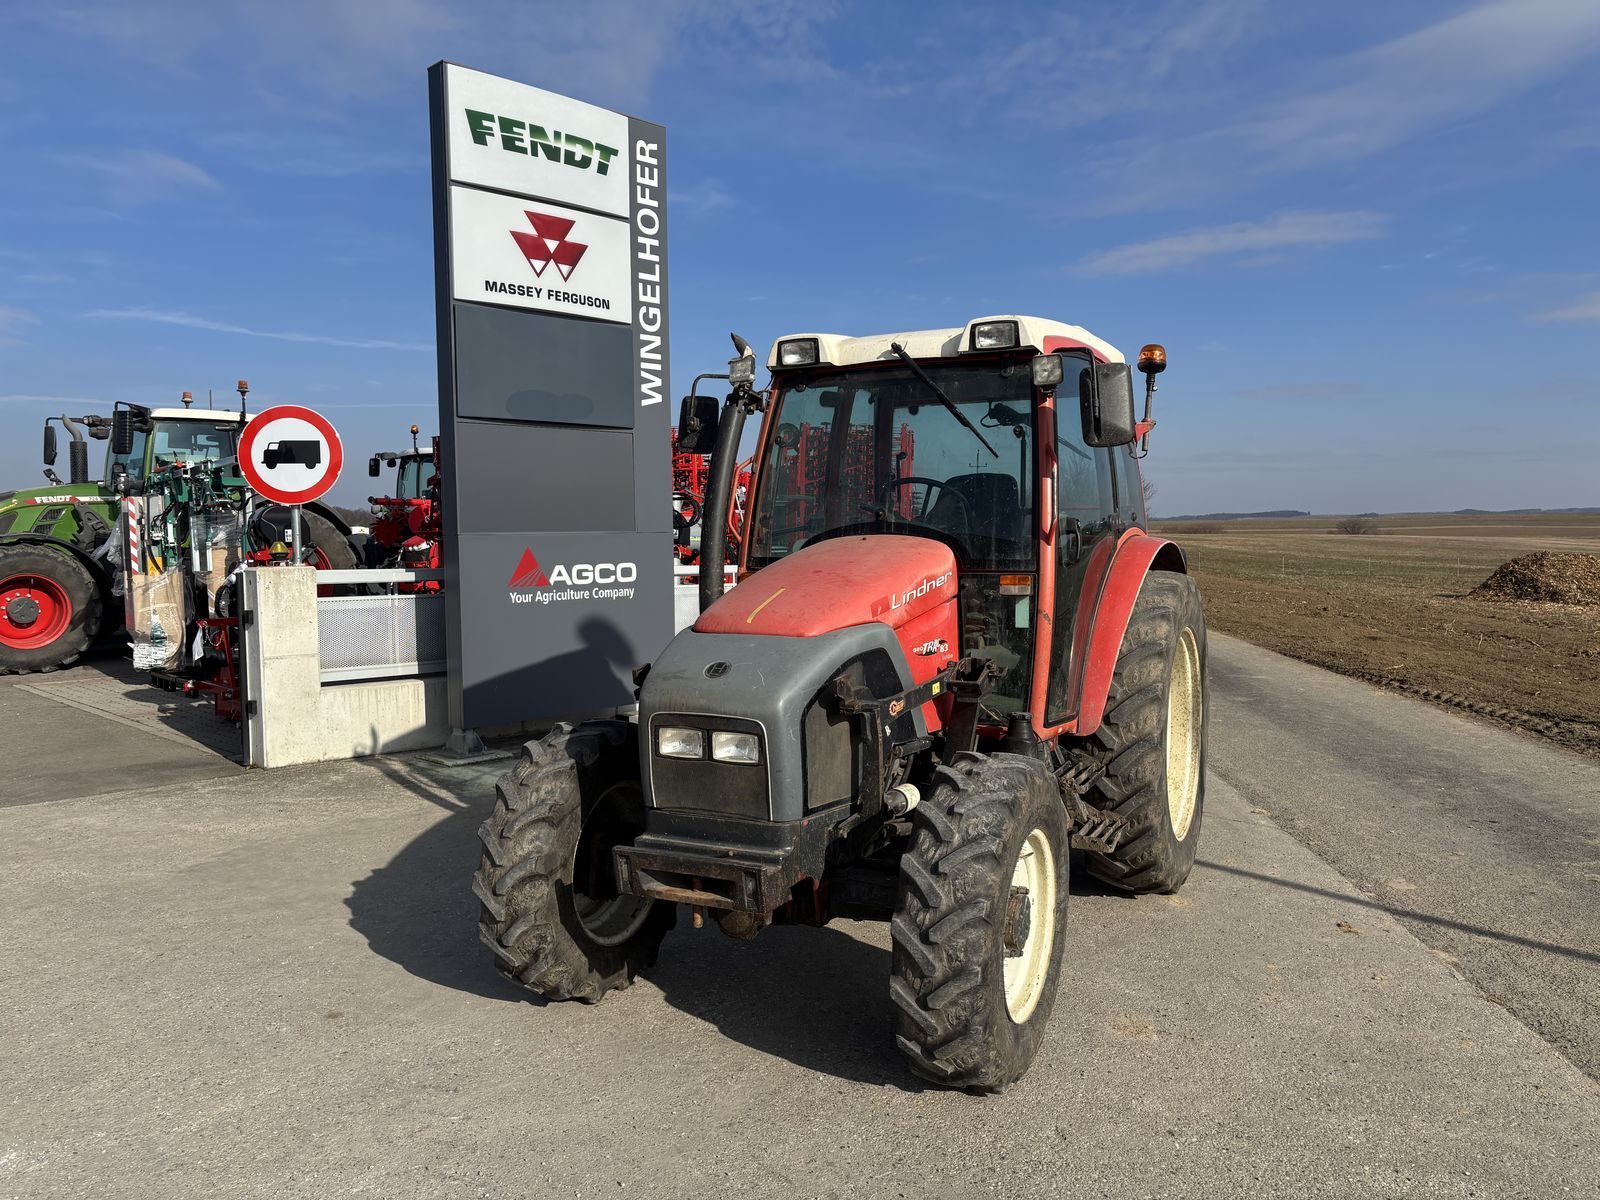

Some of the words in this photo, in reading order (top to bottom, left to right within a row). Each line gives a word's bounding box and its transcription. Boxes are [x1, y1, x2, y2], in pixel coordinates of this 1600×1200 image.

[464, 108, 619, 176] FENDT
[636, 139, 663, 407] WINGELHOFER
[485, 280, 543, 299] MASSEY
[547, 289, 610, 310] FERGUSON
[35, 495, 72, 504] FENDT
[549, 562, 637, 586] AGCO
[509, 591, 533, 604] Your
[535, 588, 590, 605] Agriculture
[592, 587, 635, 601] Company
[891, 571, 953, 610] Lindner
[939, 643, 949, 653] 83
